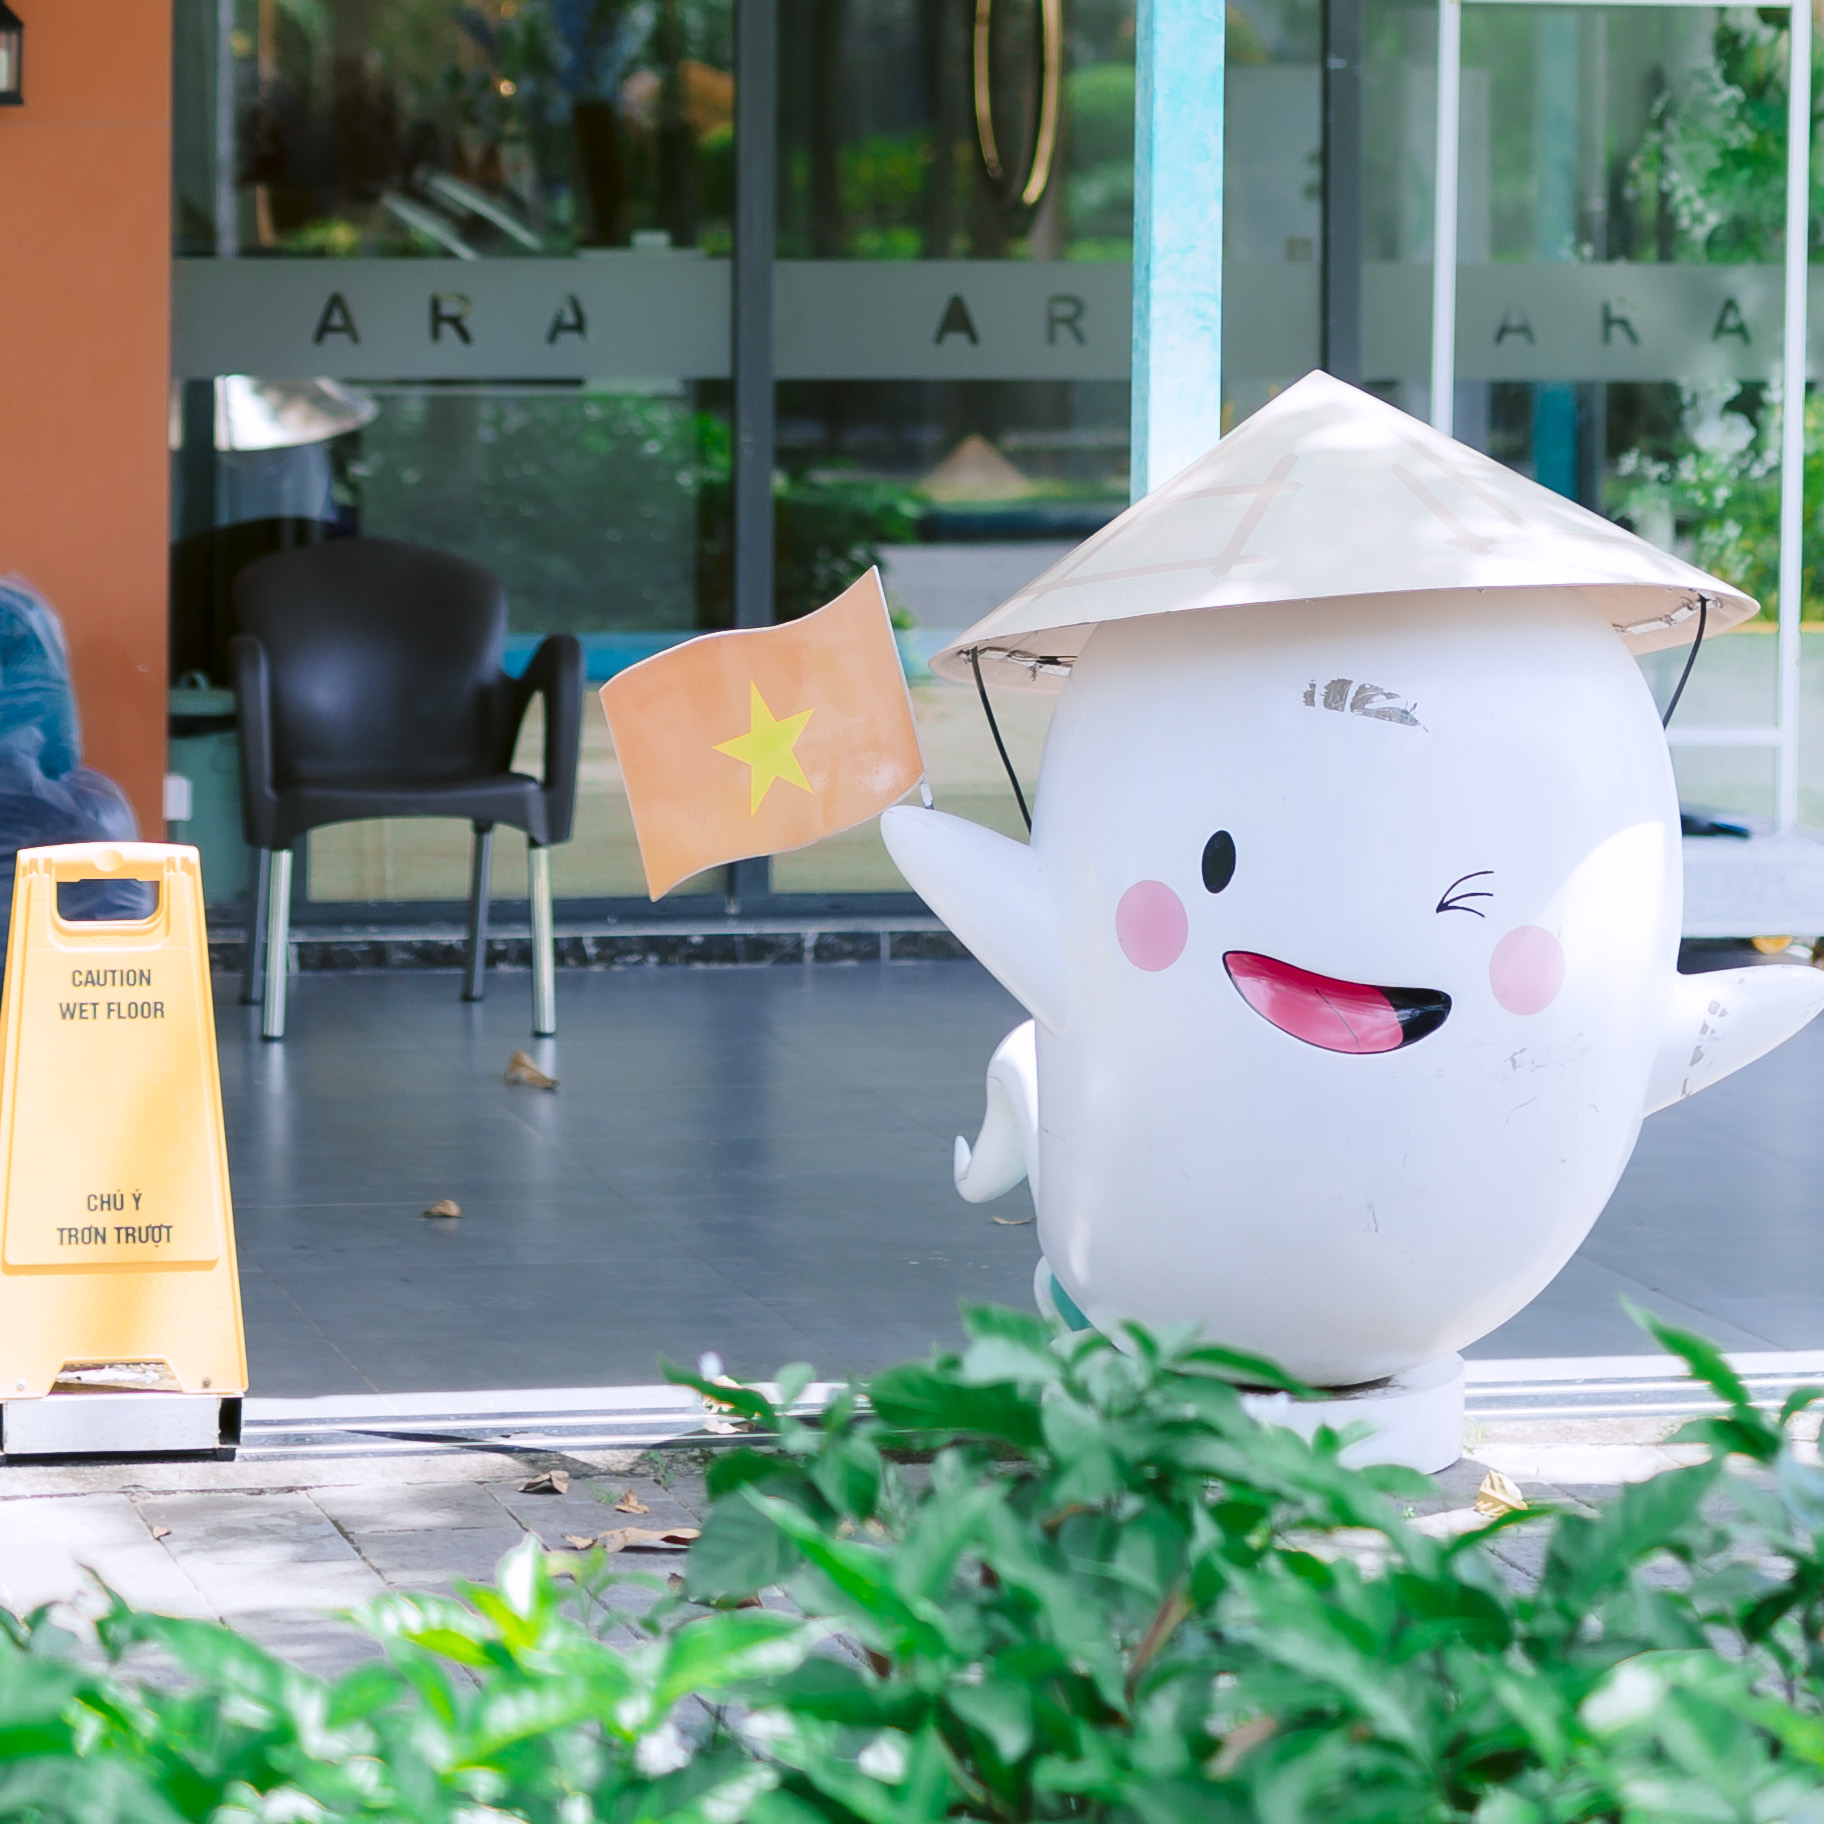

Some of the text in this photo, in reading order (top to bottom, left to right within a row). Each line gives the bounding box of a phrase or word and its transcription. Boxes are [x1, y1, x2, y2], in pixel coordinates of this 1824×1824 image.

[312, 290, 590, 346] ARA
[933, 292, 1087, 347] AR
[71, 968, 152, 988] CAUTION
[58, 1000, 166, 1020] WET FLOOR
[86, 1188, 143, 1212] CHÚ Ý
[56, 1223, 174, 1248] TRƠN TRƯỢT
